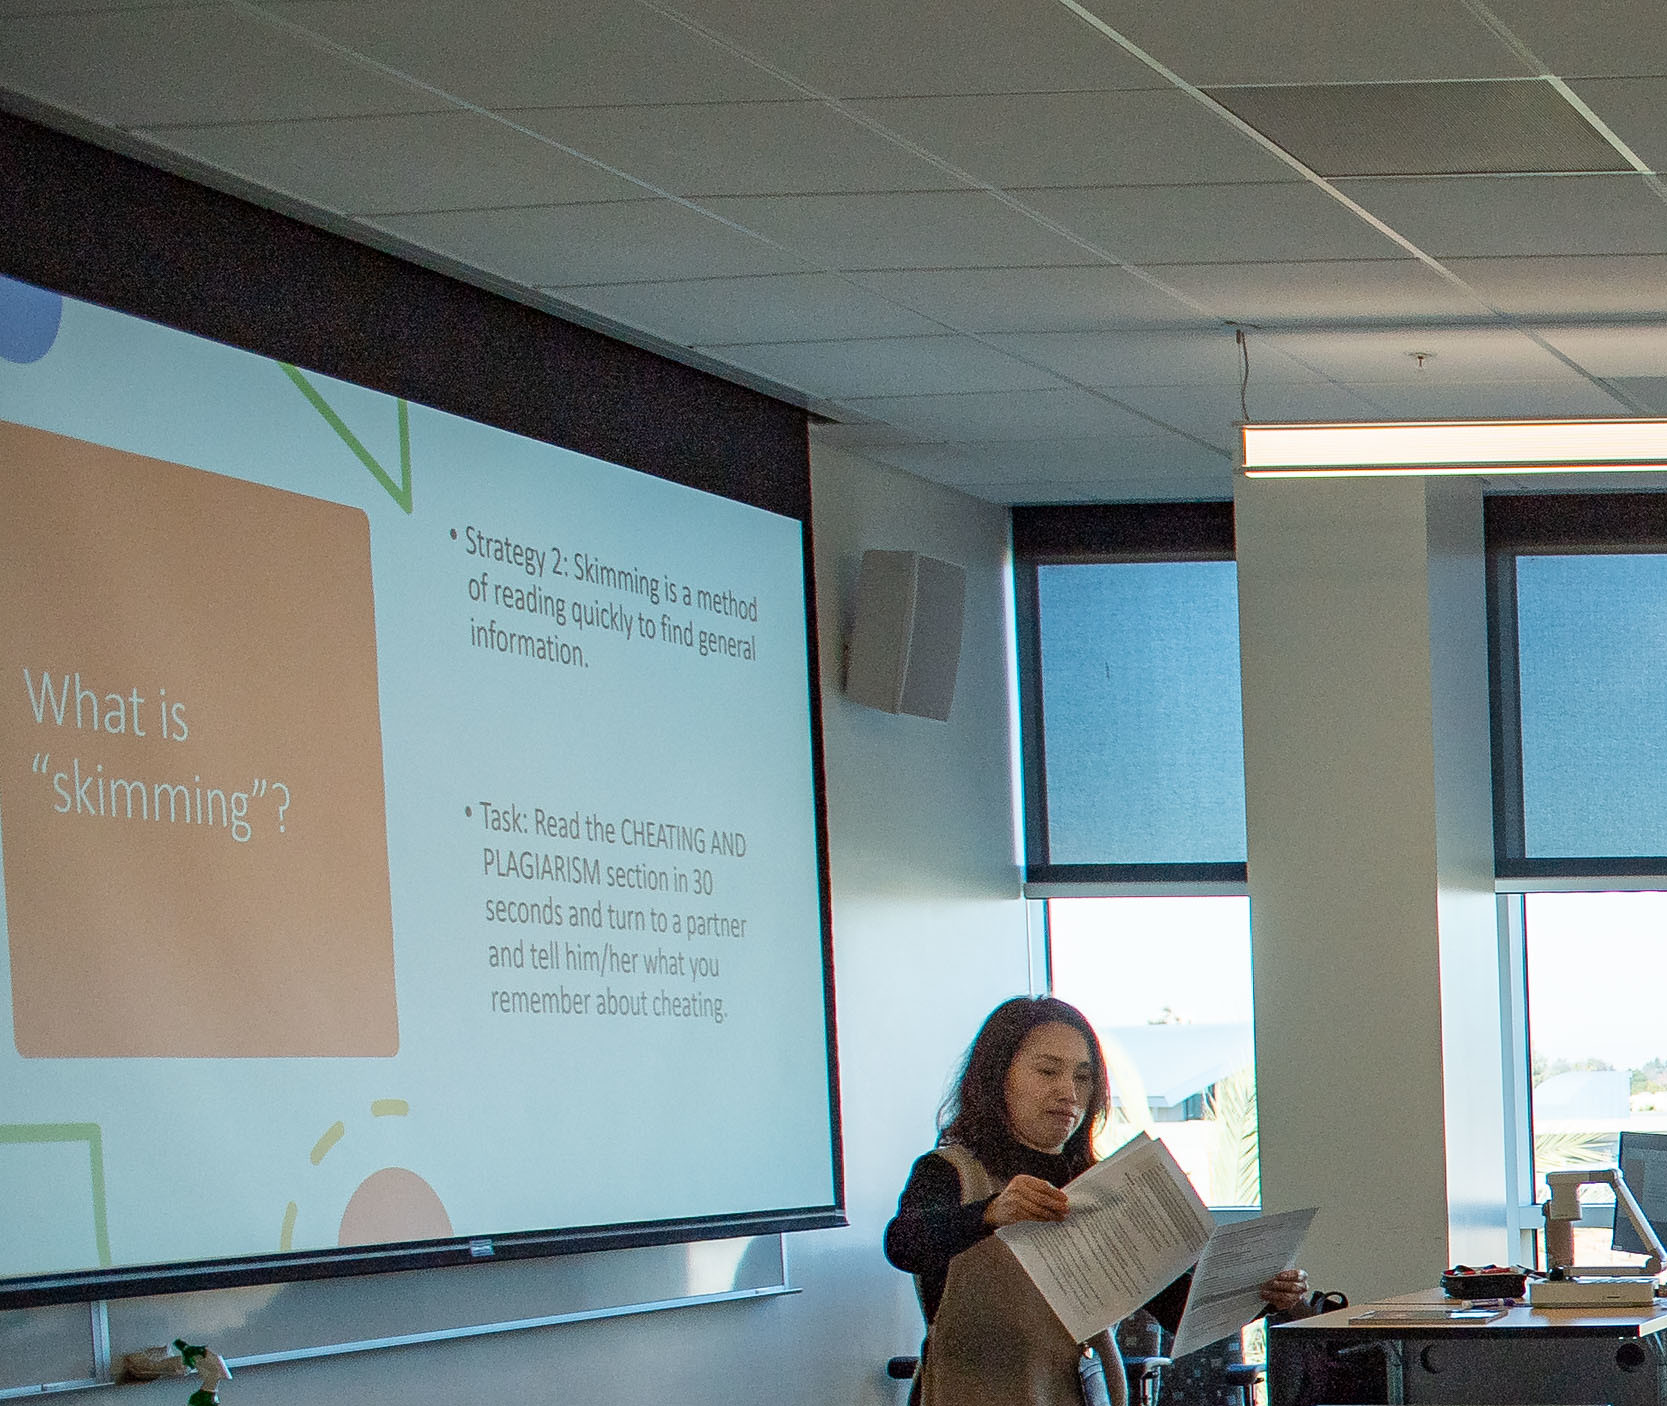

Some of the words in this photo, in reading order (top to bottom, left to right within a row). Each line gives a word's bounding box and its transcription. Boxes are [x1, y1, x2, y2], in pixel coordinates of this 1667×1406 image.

[464, 525, 546, 578] Strategy
[551, 547, 569, 578] 2:
[573, 552, 660, 606] Skimming
[664, 575, 677, 604] is
[682, 585, 693, 607] a
[697, 588, 758, 623] method
[468, 572, 489, 602] of
[494, 583, 566, 627] reading
[571, 599, 634, 641] quickly
[638, 611, 656, 640] to
[660, 613, 694, 648] find
[698, 628, 757, 662] general
[469, 617, 590, 669] information.
[23, 665, 147, 737] What
[159, 687, 190, 743] is
[479, 801, 529, 835] Task:
[534, 807, 580, 840] Read
[584, 813, 616, 844] the
[620, 818, 706, 856] CHEATING
[710, 830, 747, 858] AND
[483, 847, 601, 886] PLAGIARISM
[606, 863, 669, 892] section
[673, 866, 689, 894] in
[693, 868, 714, 896] 30
[485, 895, 563, 927] seconds
[568, 899, 601, 929] and
[607, 904, 646, 932] turn
[650, 907, 668, 934] to
[672, 912, 682, 935] a
[686, 911, 748, 942] partner
[488, 938, 524, 970] and
[530, 939, 560, 971] tell
[564, 941, 640, 978] him/her
[642, 946, 685, 976] what
[689, 956, 720, 983] you
[490, 984, 592, 1016] remember
[596, 986, 648, 1017] about
[652, 988, 729, 1025] cheating.
